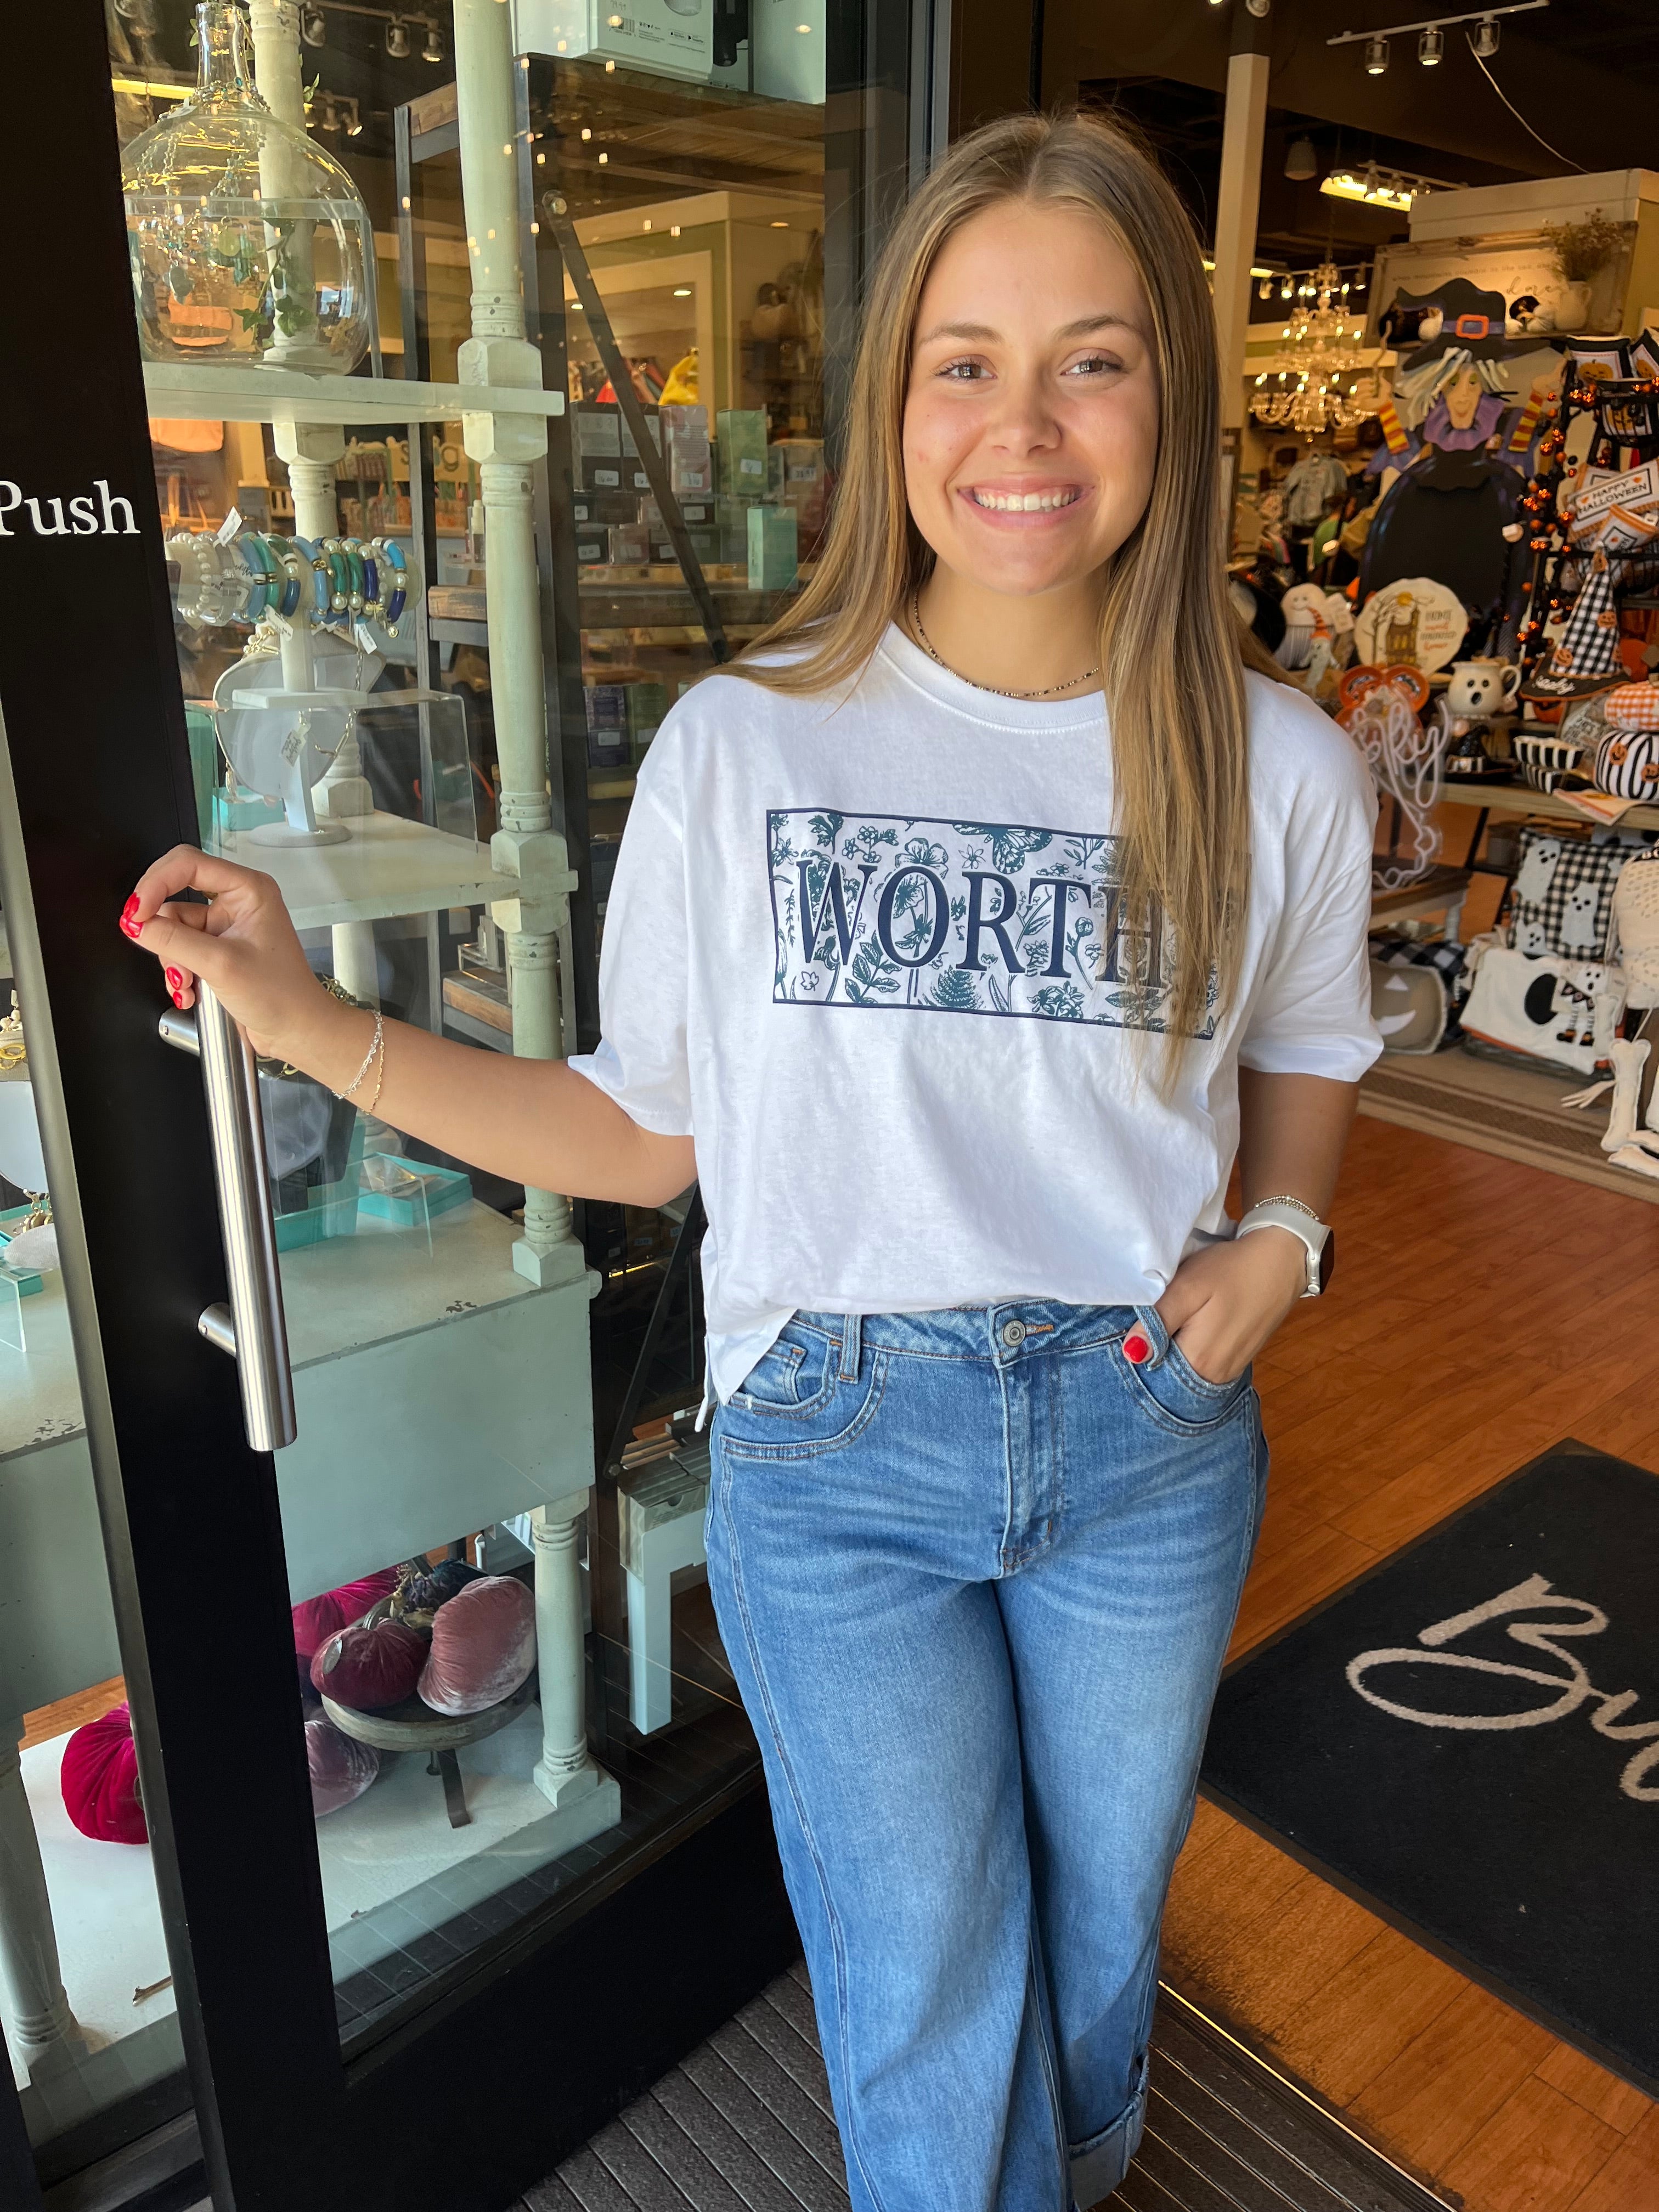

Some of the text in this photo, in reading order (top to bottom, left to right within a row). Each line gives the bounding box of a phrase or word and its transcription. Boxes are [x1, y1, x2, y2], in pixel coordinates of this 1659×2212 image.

[1578, 482, 1647, 515] HALLOWEEN
[1592, 479, 1629, 499] HAPPY
[0, 480, 141, 535] Push
